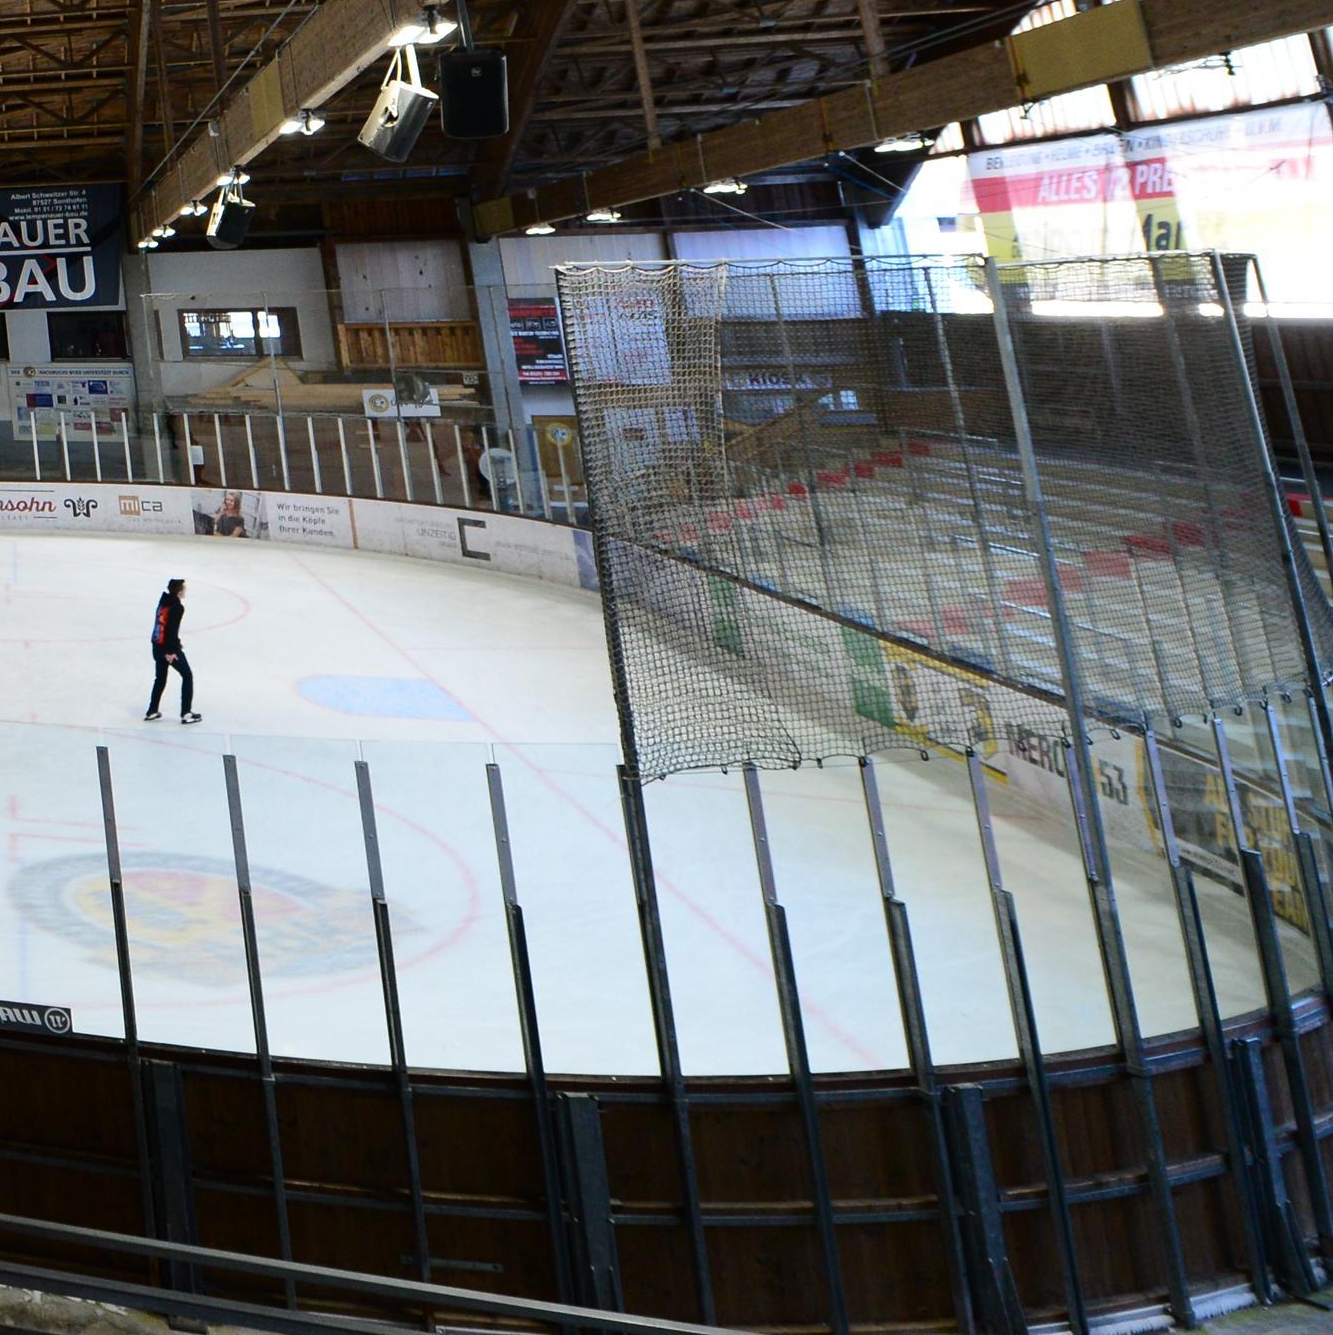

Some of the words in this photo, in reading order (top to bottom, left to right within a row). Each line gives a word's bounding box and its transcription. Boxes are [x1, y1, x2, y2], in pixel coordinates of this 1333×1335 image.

[1037, 169, 1098, 204] ALLES
[119, 495, 163, 515] mica
[277, 502, 291, 512] Wir
[292, 503, 323, 516] bringen
[326, 507, 340, 516] Sie
[287, 513, 299, 523] die
[278, 525, 299, 535] Ihrer
